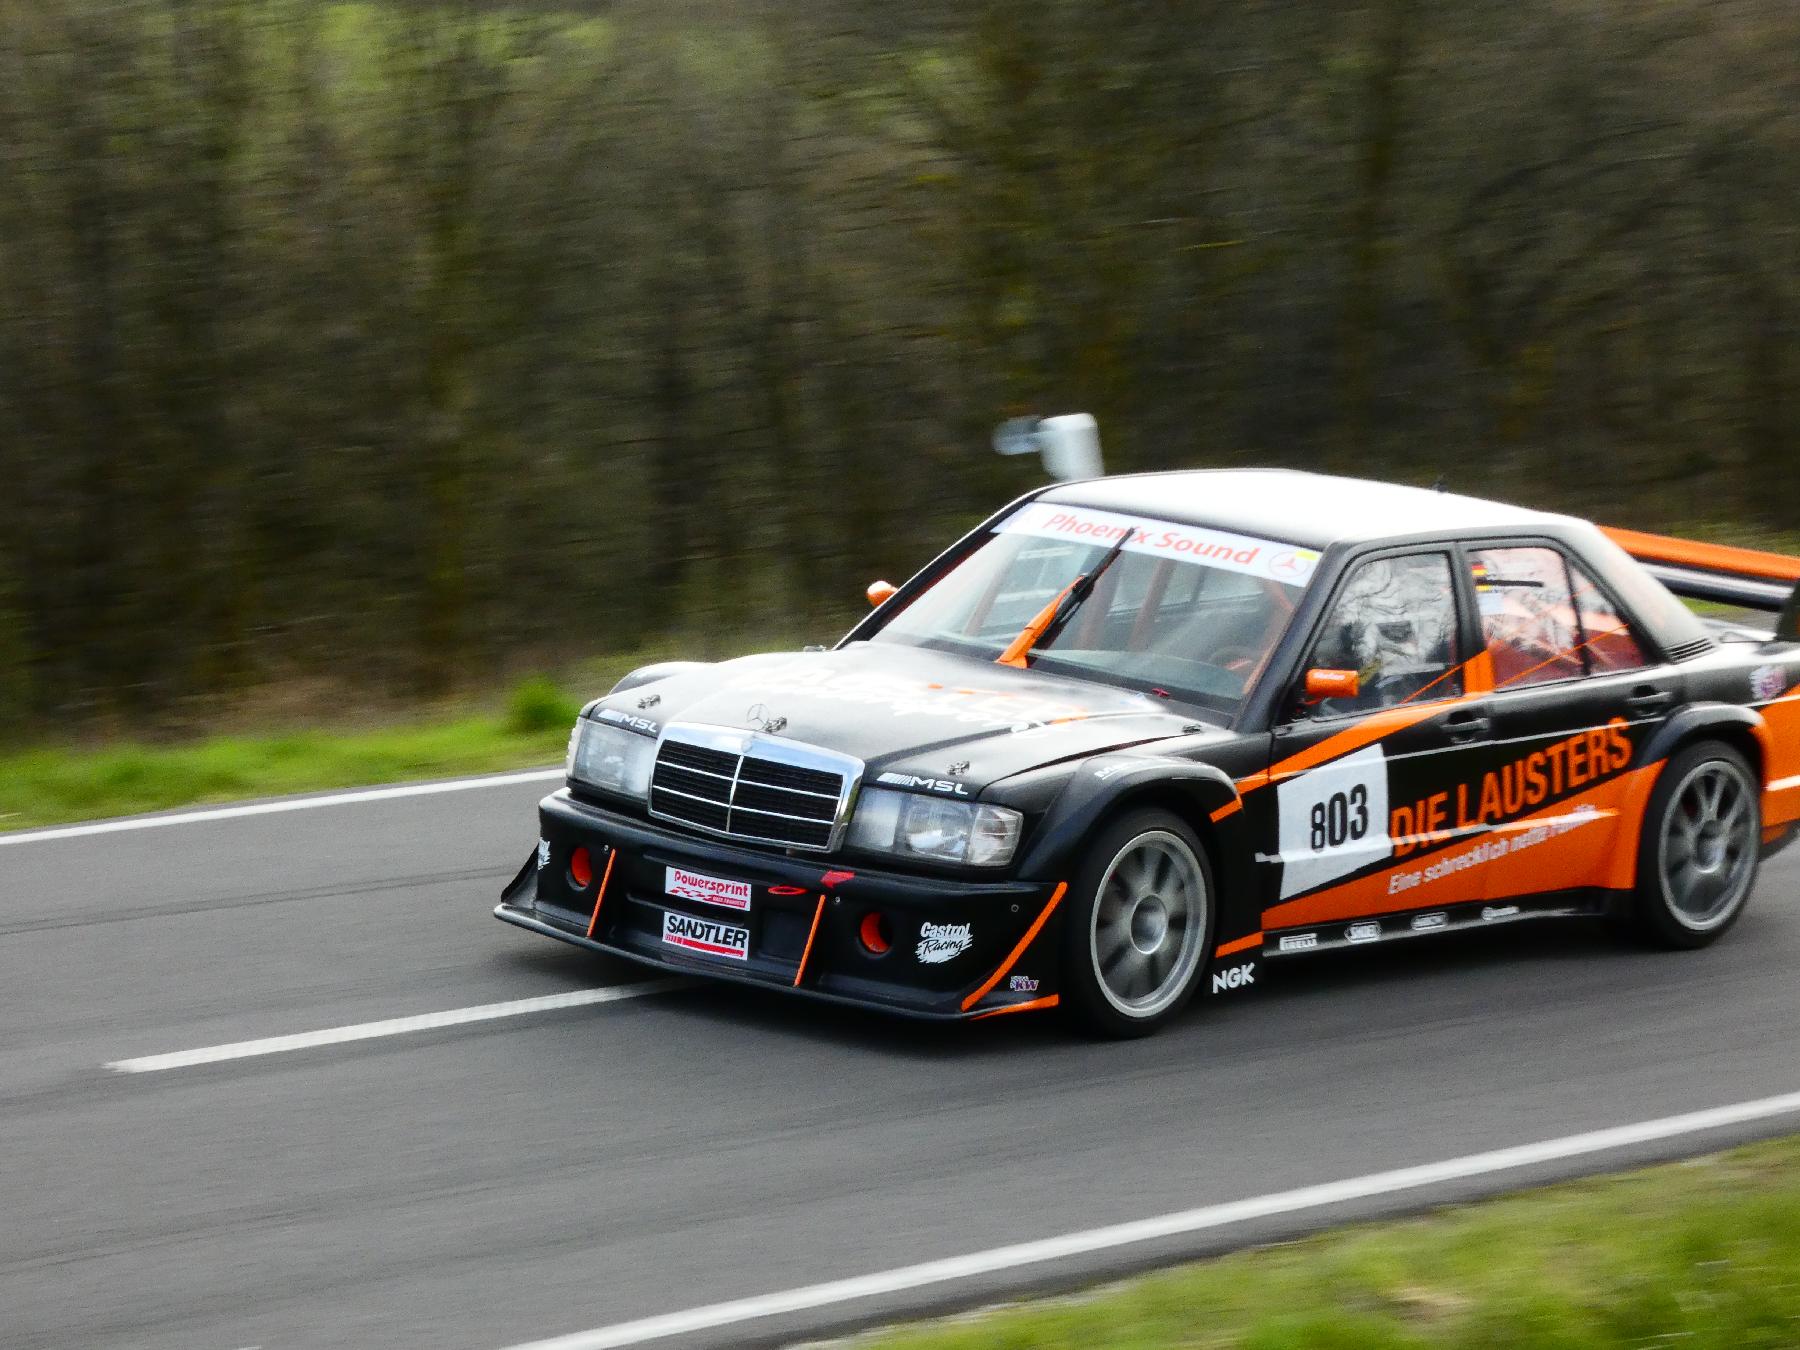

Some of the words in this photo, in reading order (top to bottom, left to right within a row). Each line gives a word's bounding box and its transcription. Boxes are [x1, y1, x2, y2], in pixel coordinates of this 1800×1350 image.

[1154, 531, 1263, 565] Sound
[619, 713, 657, 733] MSL
[911, 776, 969, 796] MSL
[1391, 792, 1449, 857] DIE
[1457, 716, 1633, 829] LAUSTERS
[1310, 783, 1369, 853] 803
[674, 870, 749, 897] Powersprint
[667, 915, 748, 949] SANDTLER
[920, 921, 971, 939] Castrol
[922, 939, 965, 957] Racing
[1212, 962, 1256, 994] NGK
